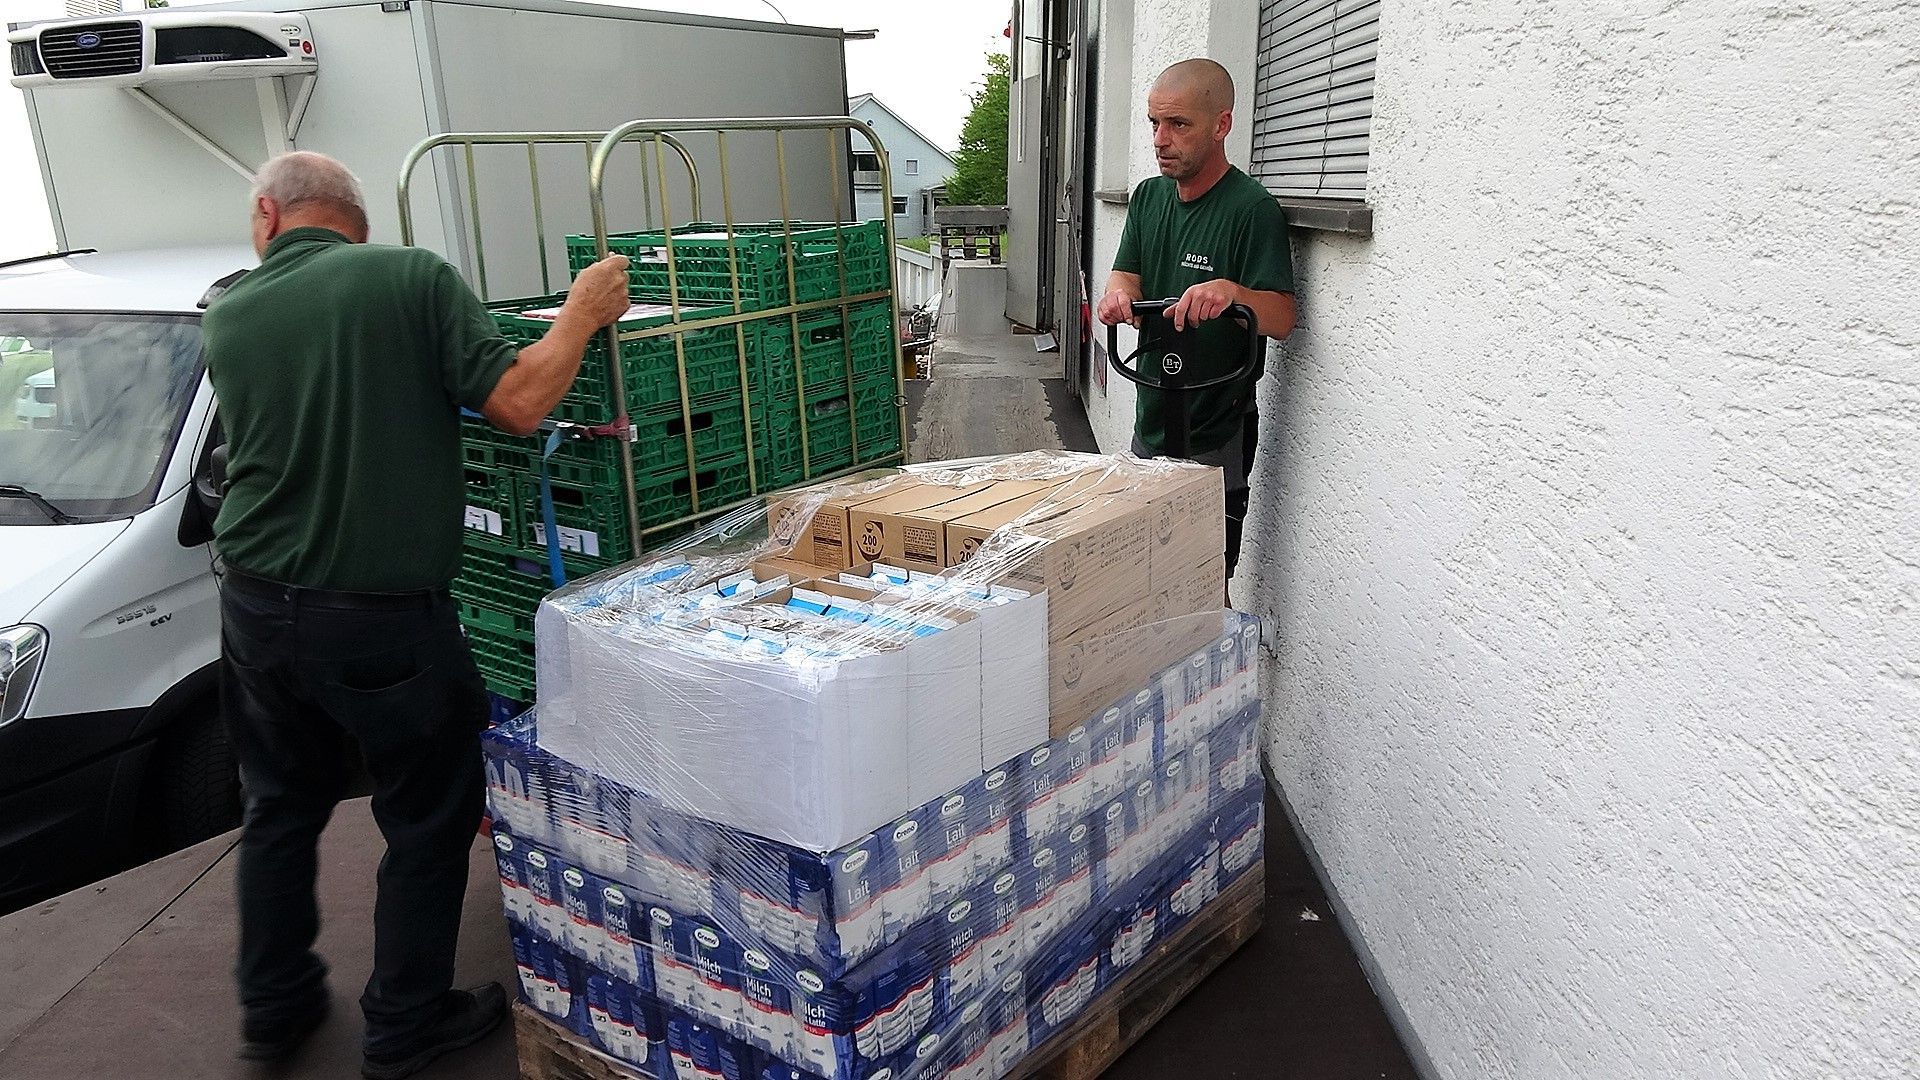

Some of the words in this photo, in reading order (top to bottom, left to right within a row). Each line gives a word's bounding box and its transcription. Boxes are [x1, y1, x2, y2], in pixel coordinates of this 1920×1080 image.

[1186, 253, 1208, 264] RODS
[862, 534, 877, 546] 200
[1137, 713, 1151, 729] Lait
[1105, 732, 1121, 749] Lait
[1034, 751, 1049, 763] Cremo
[1070, 752, 1086, 769] Lait
[988, 774, 1005, 787] Cremo
[1034, 774, 1051, 793] Lait
[944, 798, 962, 812] Cremo
[990, 800, 1006, 819] Lait
[896, 823, 915, 837] Cremo
[946, 823, 965, 844] Lait
[845, 854, 865, 870] Cremo
[899, 851, 920, 873] Lait
[606, 890, 623, 903] Cremo
[847, 880, 870, 904] Lait
[950, 905, 970, 920] Cremo
[606, 911, 628, 932] Milch
[697, 931, 717, 946] Cremo
[951, 927, 974, 949] Milch
[746, 953, 767, 967] Cremo
[746, 977, 772, 998] Milch
[799, 973, 820, 989] Cremo
[919, 1060, 942, 1080] Milch
